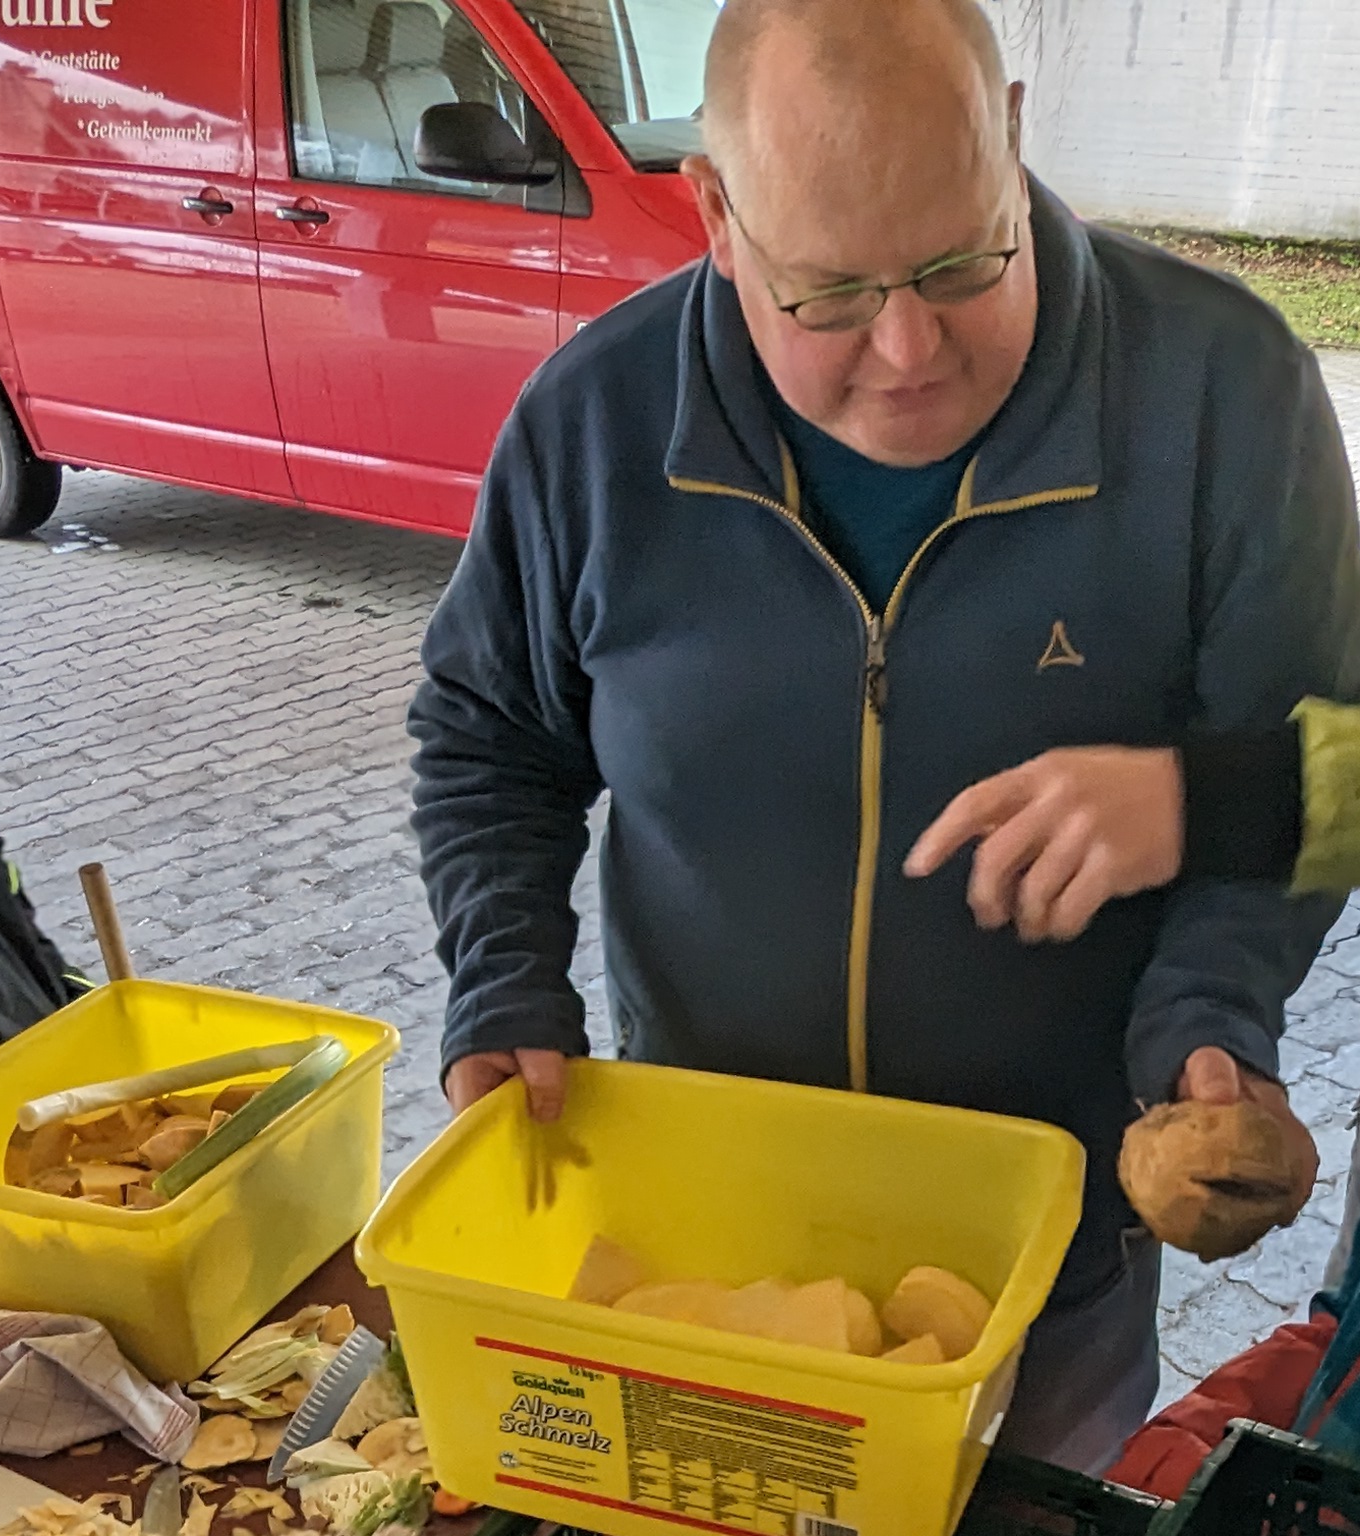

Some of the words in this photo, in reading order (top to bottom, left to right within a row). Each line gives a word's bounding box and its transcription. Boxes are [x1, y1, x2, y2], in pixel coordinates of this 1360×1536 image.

[40, 50, 121, 71] Gaststätte
[87, 120, 213, 142] Getränkemarkt
[512, 1373, 586, 1399] Goldquell
[510, 1393, 593, 1427] Alpen
[499, 1412, 612, 1455] Schmelz
